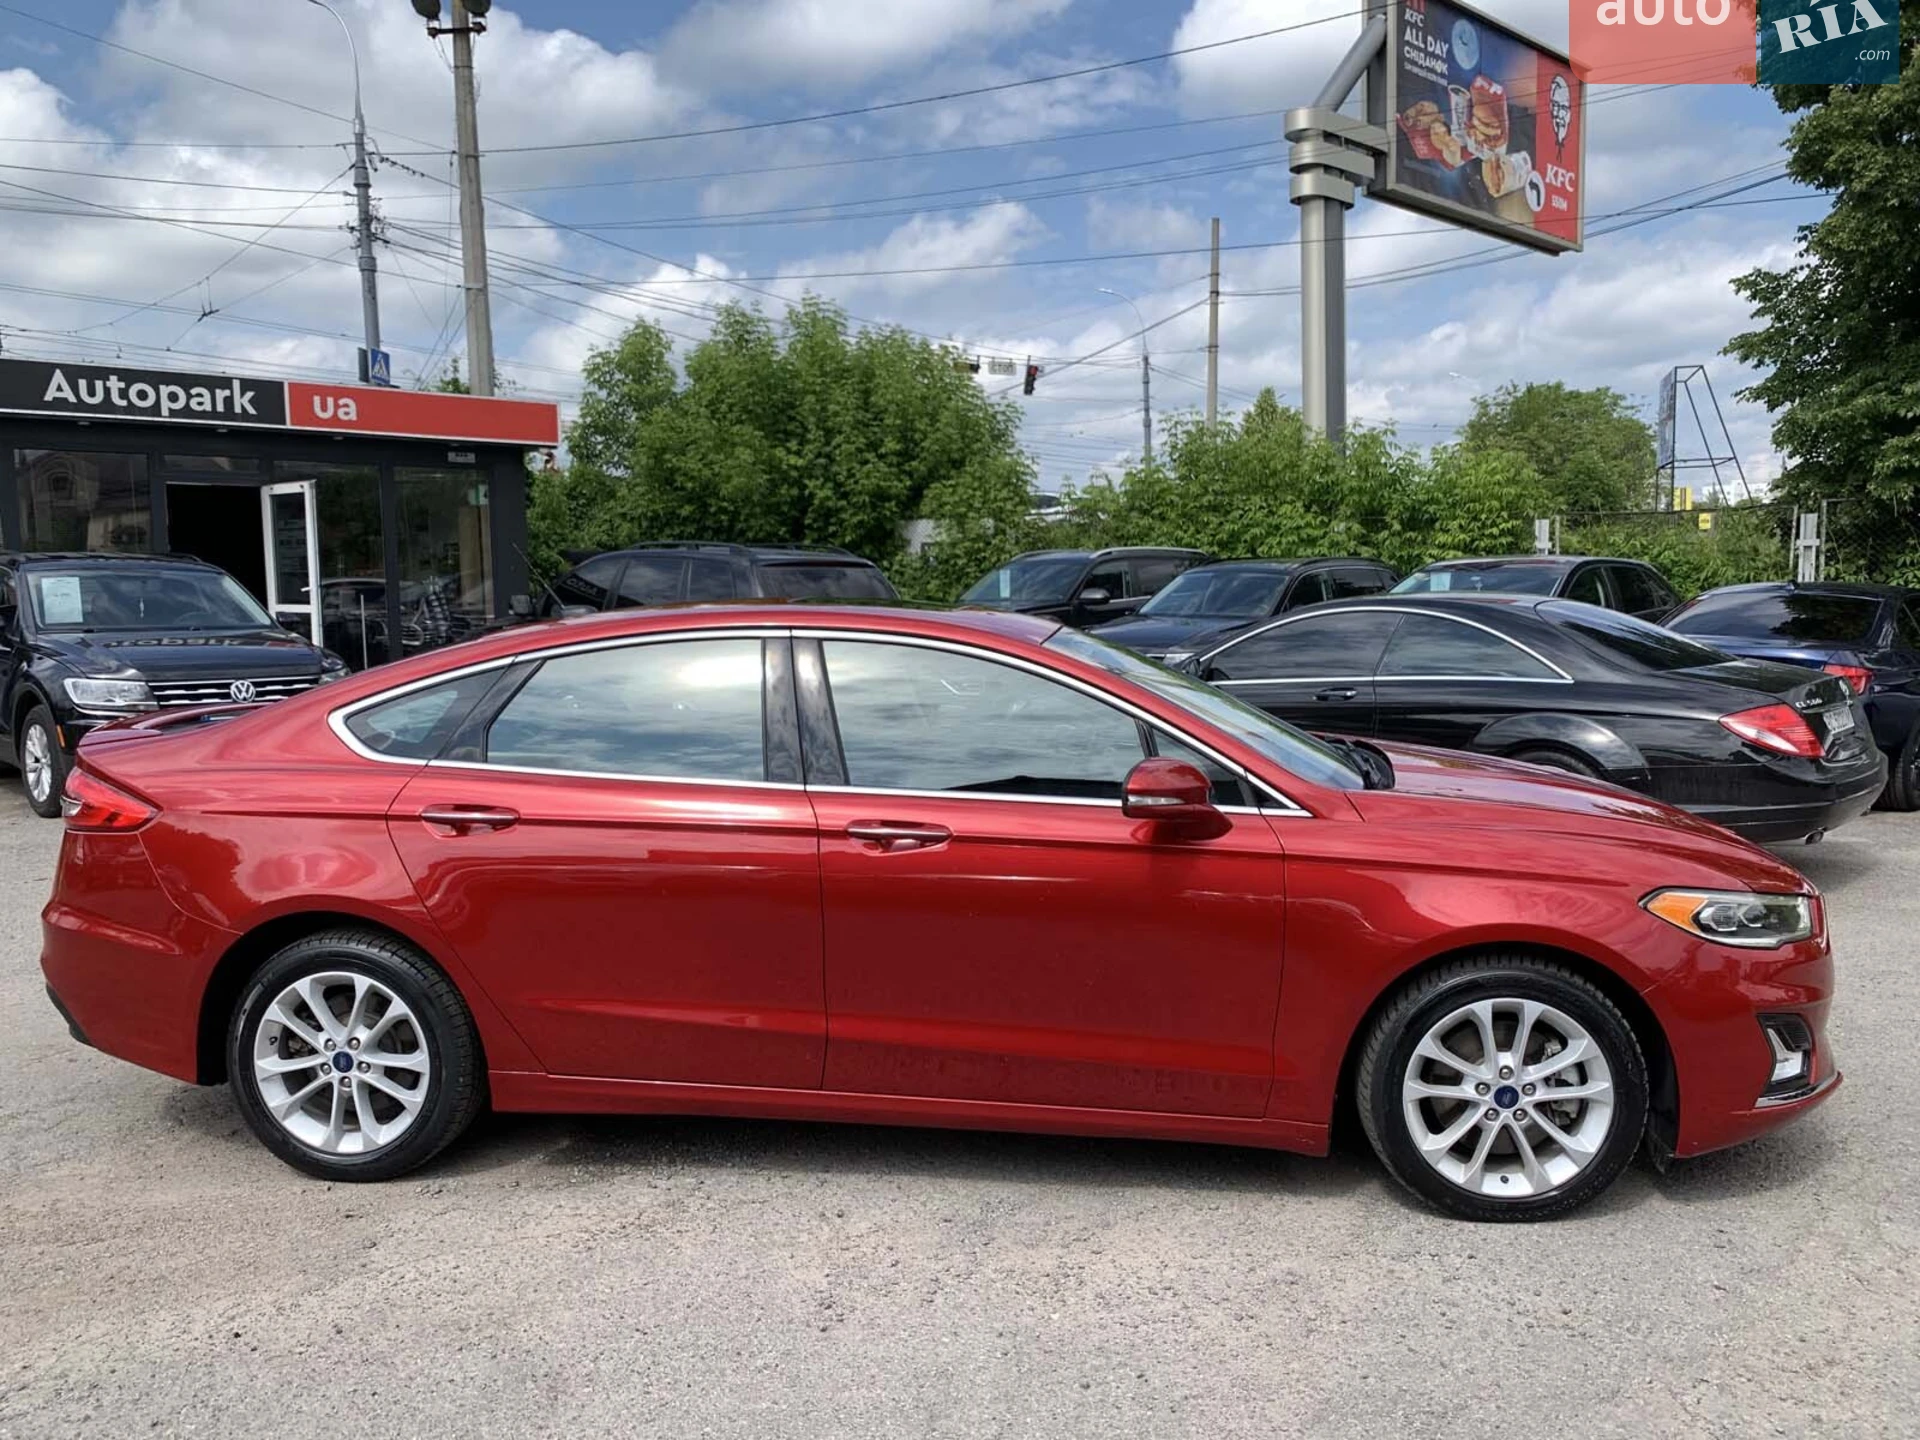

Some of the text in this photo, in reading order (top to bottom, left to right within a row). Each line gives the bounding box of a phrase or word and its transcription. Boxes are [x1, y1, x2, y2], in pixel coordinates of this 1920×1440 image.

[1404, 8, 1425, 27] KFC
[1404, 25, 1449, 58] ALL DAY
[1545, 163, 1575, 193] KFC
[43, 368, 357, 421] Autopark ua
